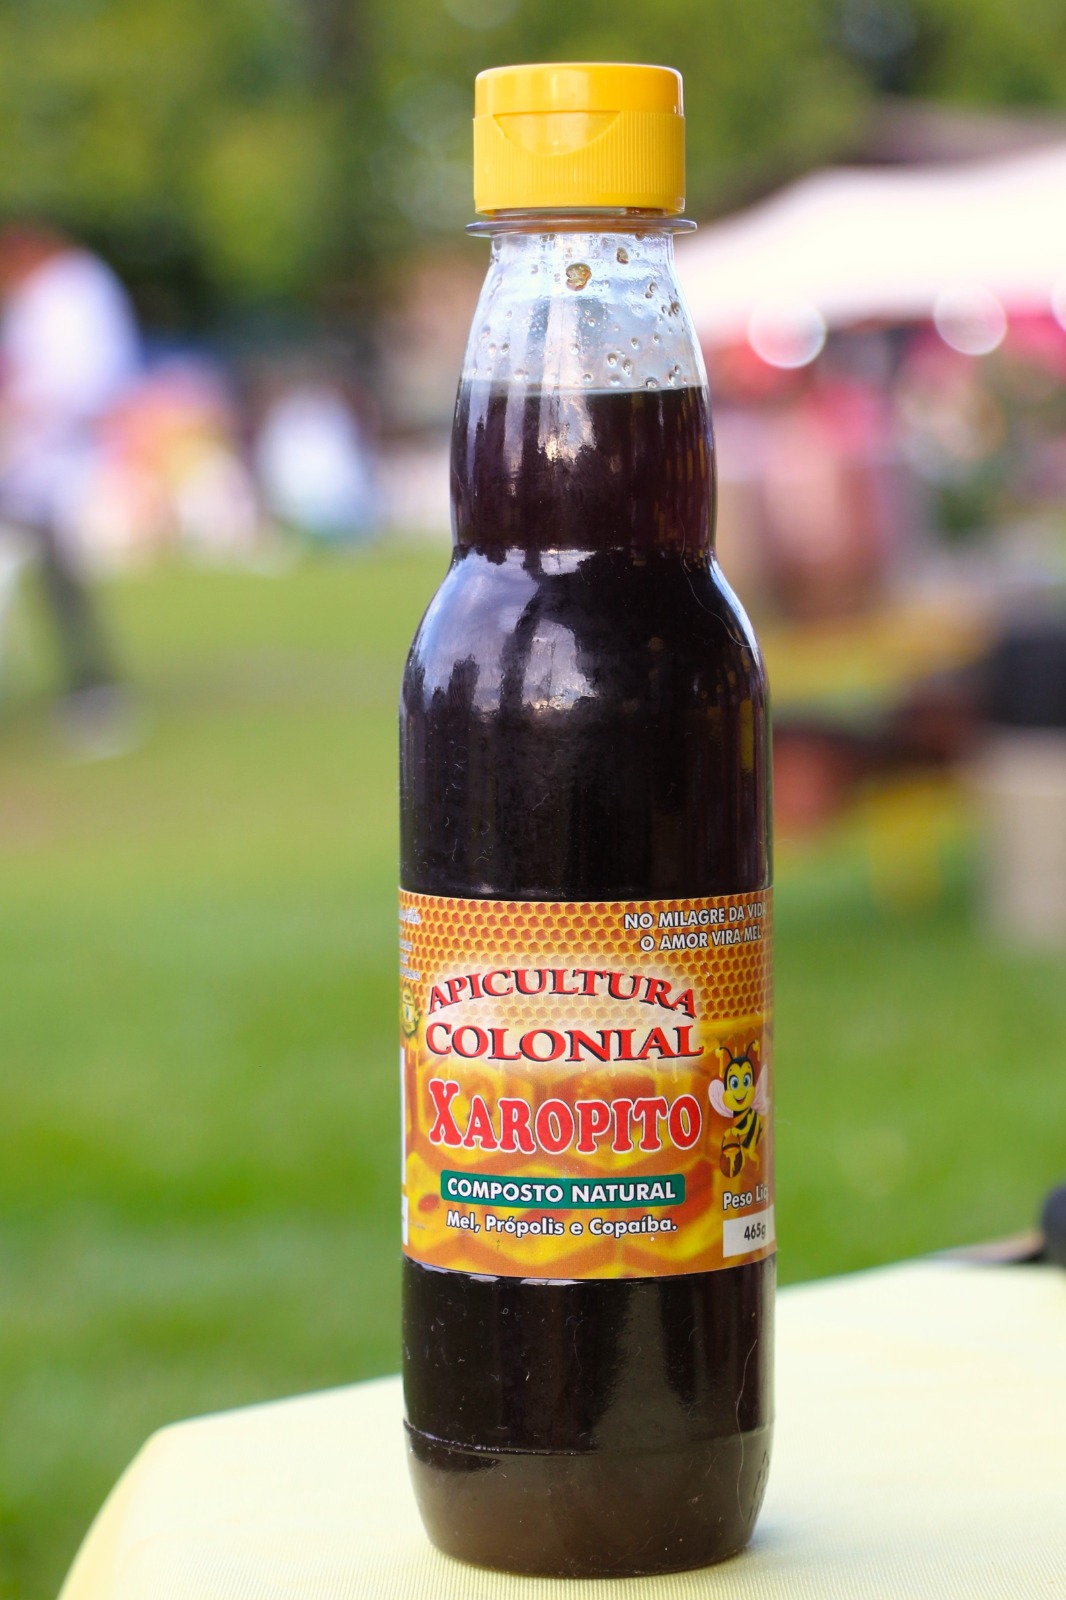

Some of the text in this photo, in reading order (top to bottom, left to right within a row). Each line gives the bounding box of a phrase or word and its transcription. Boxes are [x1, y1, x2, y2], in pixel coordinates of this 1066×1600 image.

[624, 913, 653, 929] NO
[658, 908, 725, 928] MILAGRE
[729, 907, 745, 922] DA
[640, 925, 761, 951] O AMOR VIRA MEL
[428, 968, 698, 1018] APICULTURA
[426, 1022, 704, 1062] COLONIAL
[428, 1077, 702, 1154] XAROPITO
[447, 1177, 676, 1203] COMPOSTO NATURAL
[723, 1191, 753, 1210] Peso
[447, 1210, 480, 1231] Mel,
[484, 1215, 564, 1236] Própolis
[571, 1222, 583, 1235] e
[589, 1218, 678, 1239] Copaíba.
[744, 1222, 766, 1241] 465g
